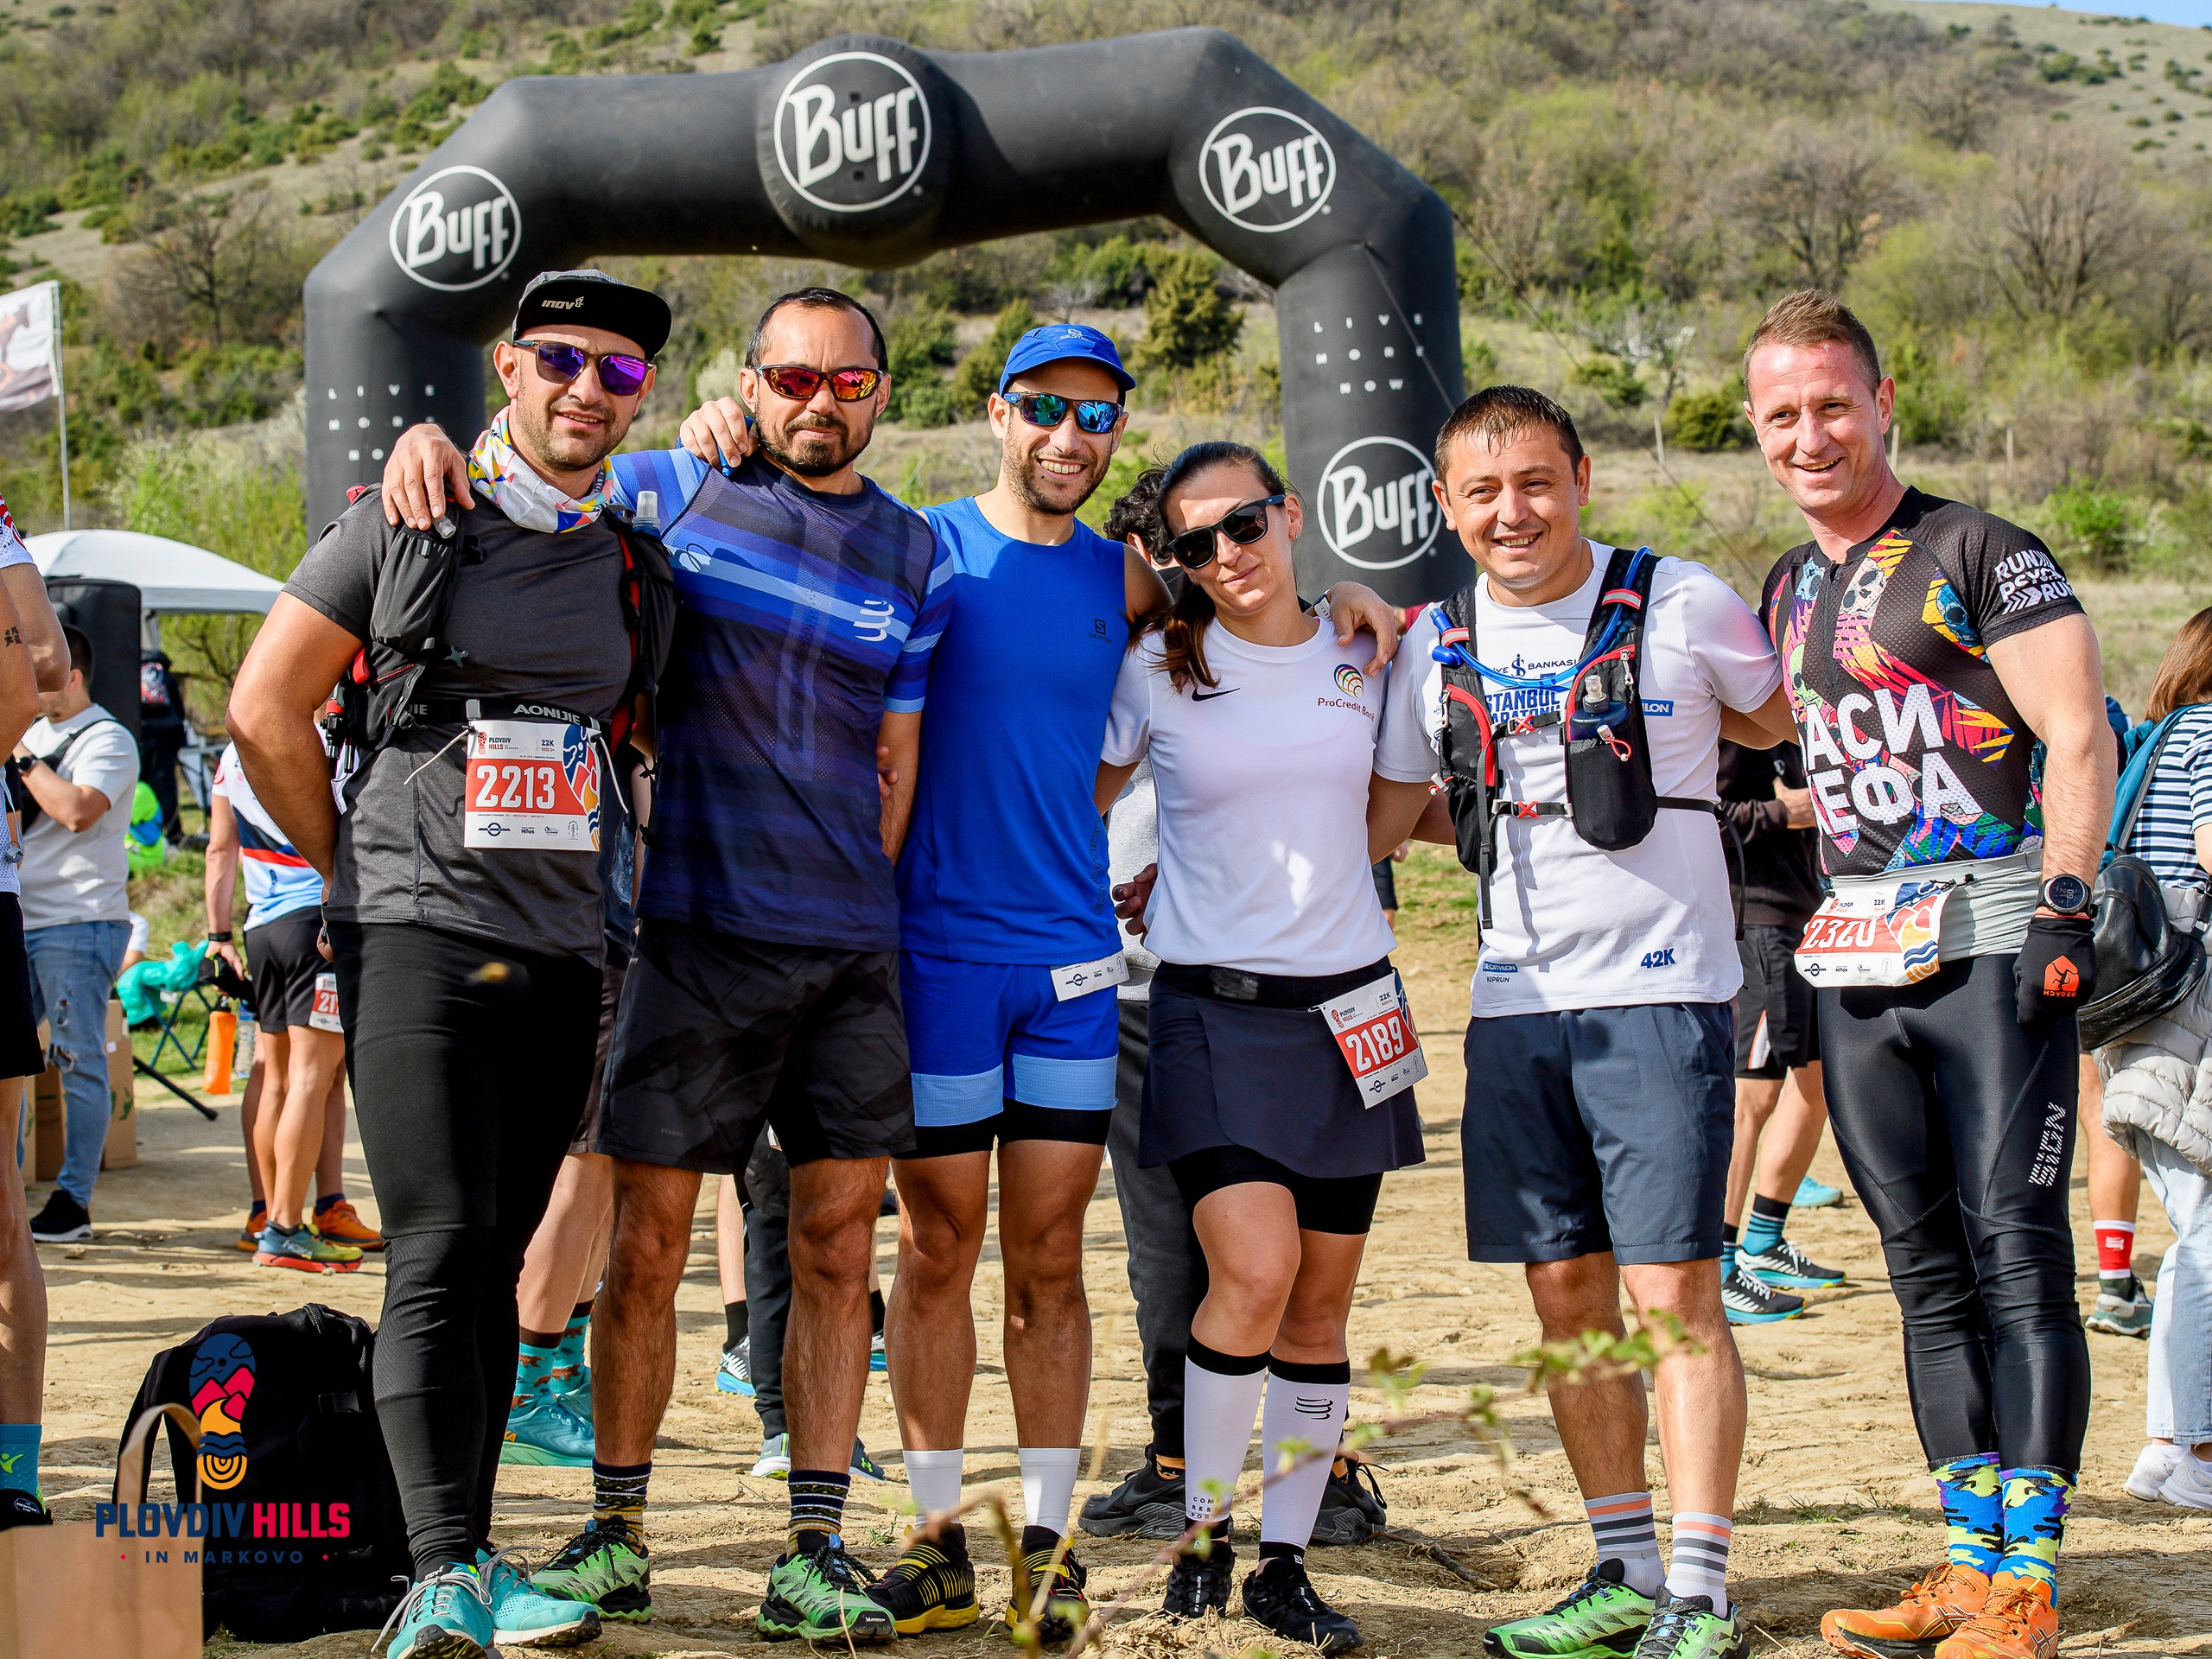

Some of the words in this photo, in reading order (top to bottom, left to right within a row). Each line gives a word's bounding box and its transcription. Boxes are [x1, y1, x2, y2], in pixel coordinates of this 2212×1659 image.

[1313, 313, 1423, 334] LIVE
[1315, 346, 1425, 365] MORE
[1339, 378, 1404, 395] NOW
[348, 448, 385, 461] NO
[513, 703, 582, 725] AONIJIE
[1317, 696, 1362, 714] ProCredit
[1792, 683, 1945, 772] АСИ
[475, 765, 556, 810] 2213
[1640, 948, 1676, 969] 42K
[1378, 991, 1392, 1001] 22K
[1344, 1015, 1405, 1073] 2189
